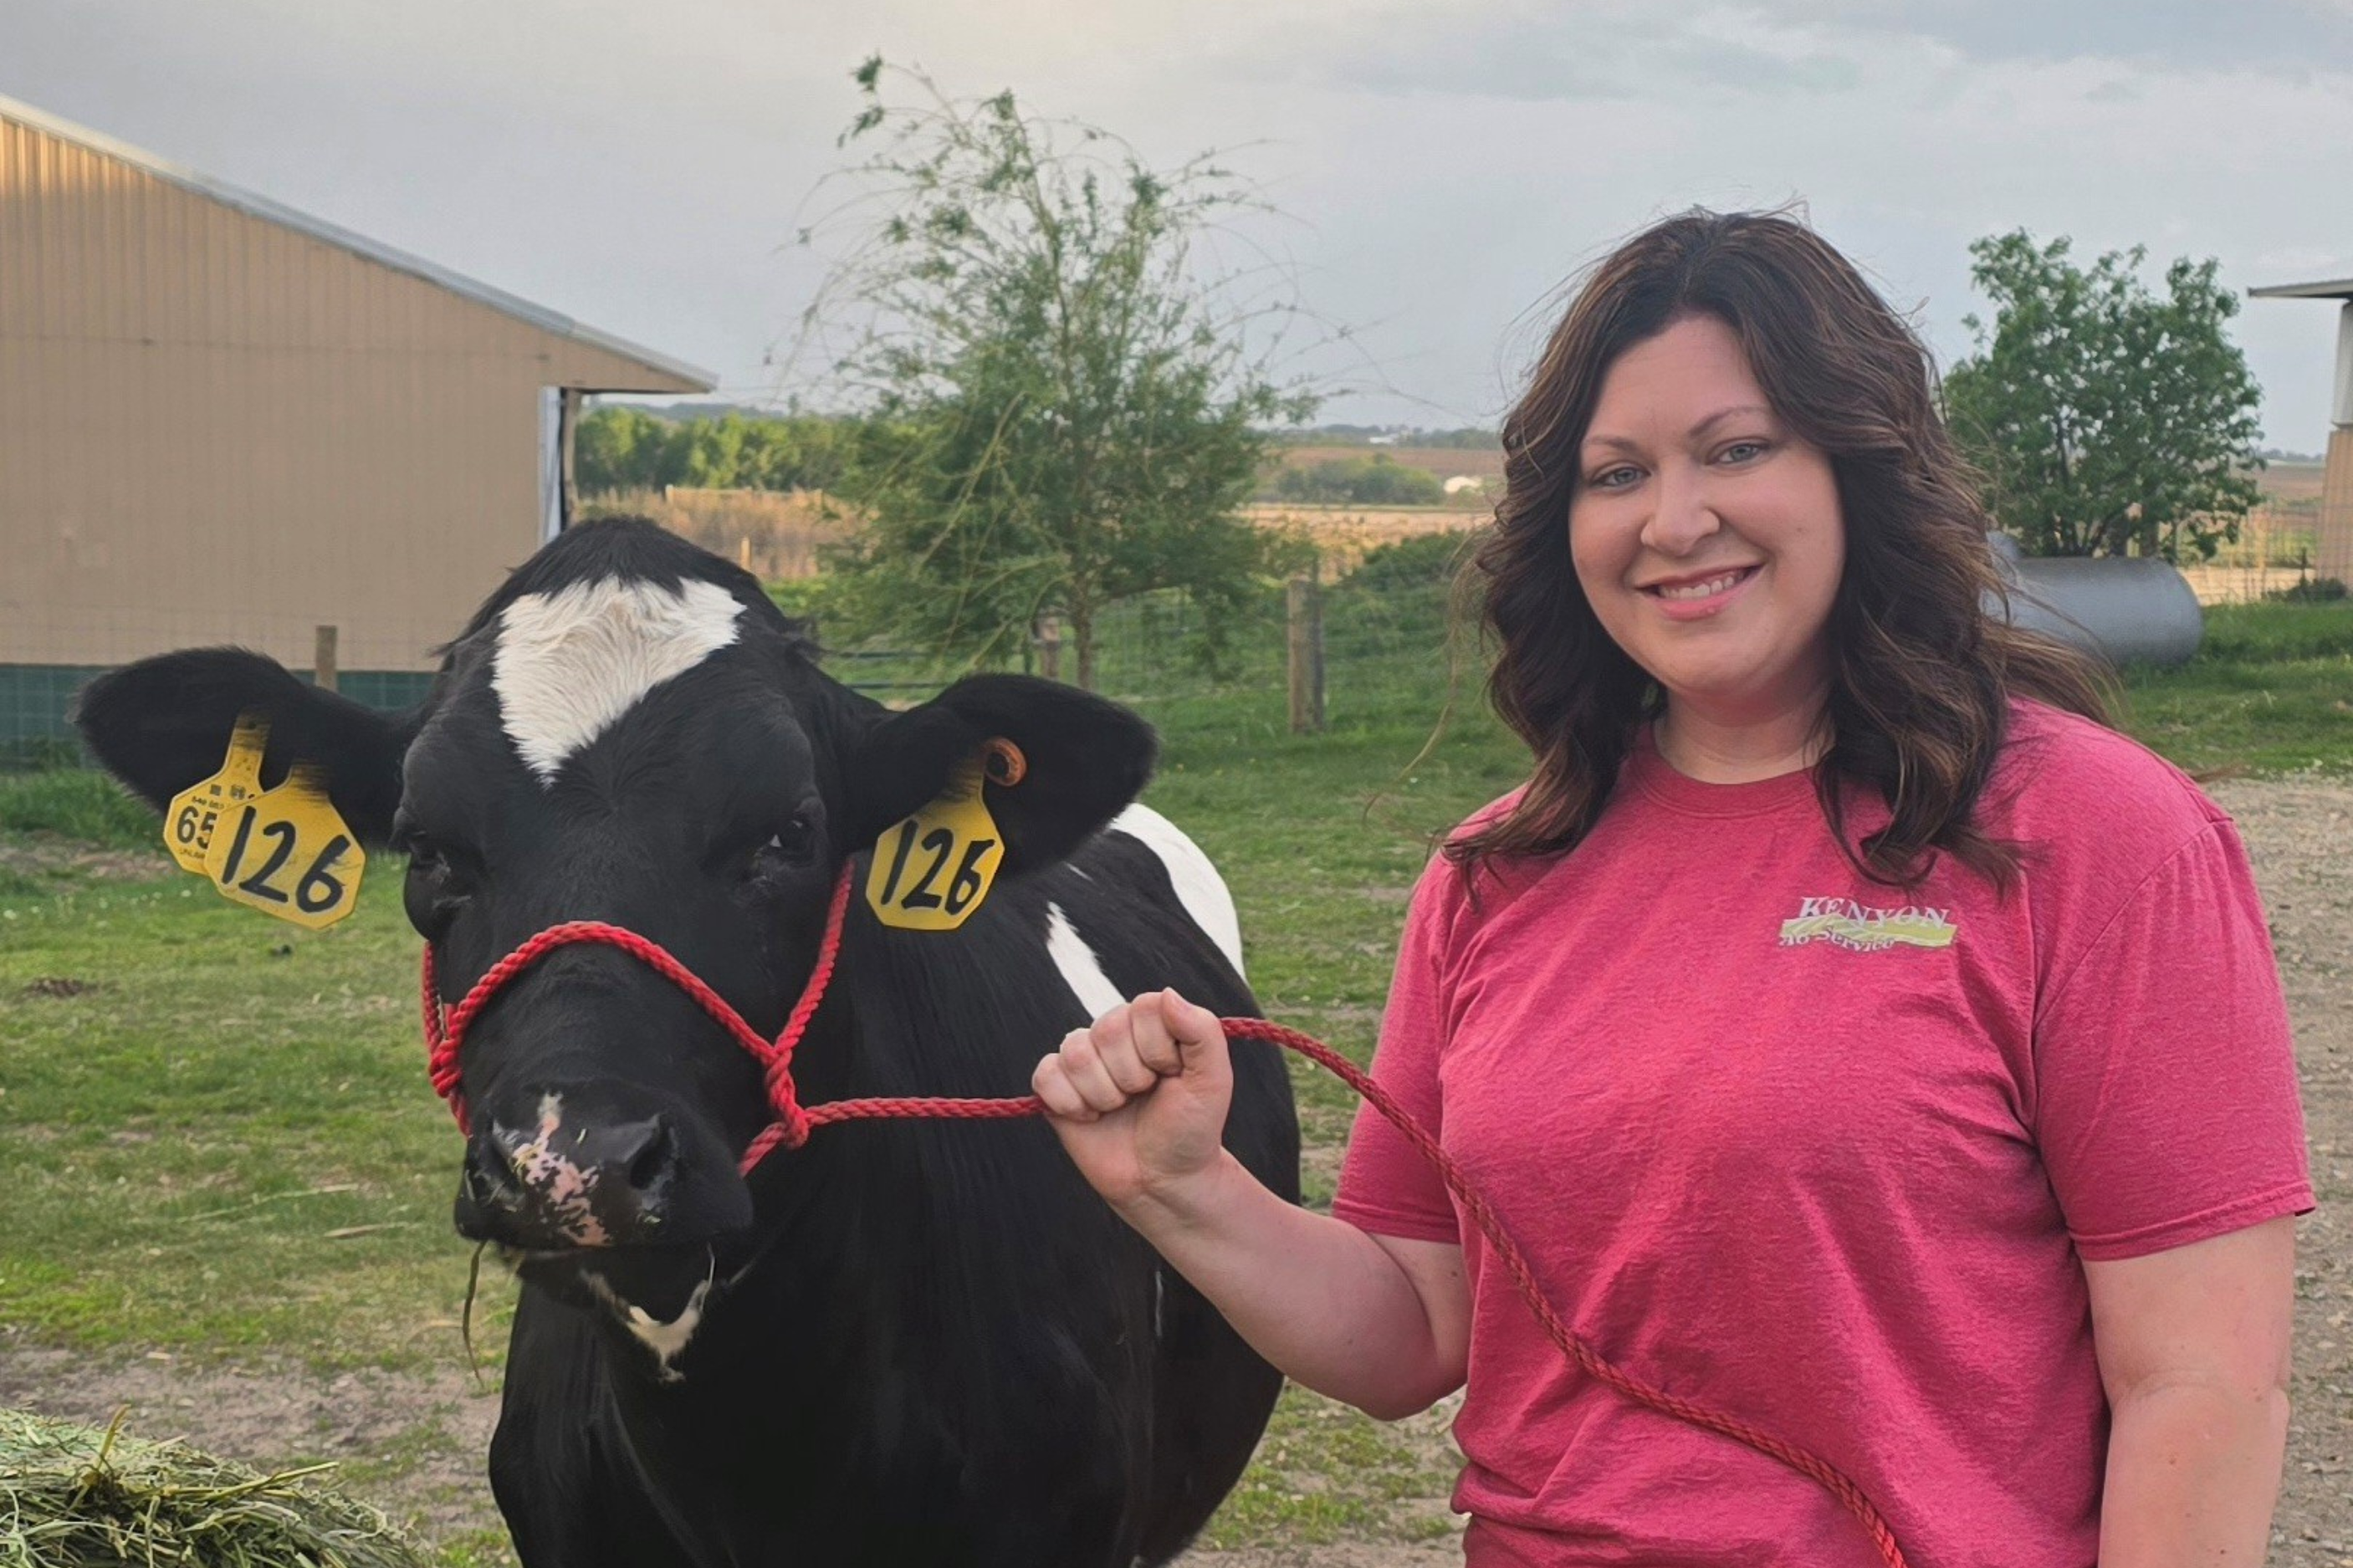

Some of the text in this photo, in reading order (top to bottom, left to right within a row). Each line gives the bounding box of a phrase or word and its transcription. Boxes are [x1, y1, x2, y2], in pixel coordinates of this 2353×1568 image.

[177, 805, 217, 850] 65
[221, 804, 351, 913] 126
[880, 819, 995, 916] 126
[1798, 896, 1950, 929] KENYON
